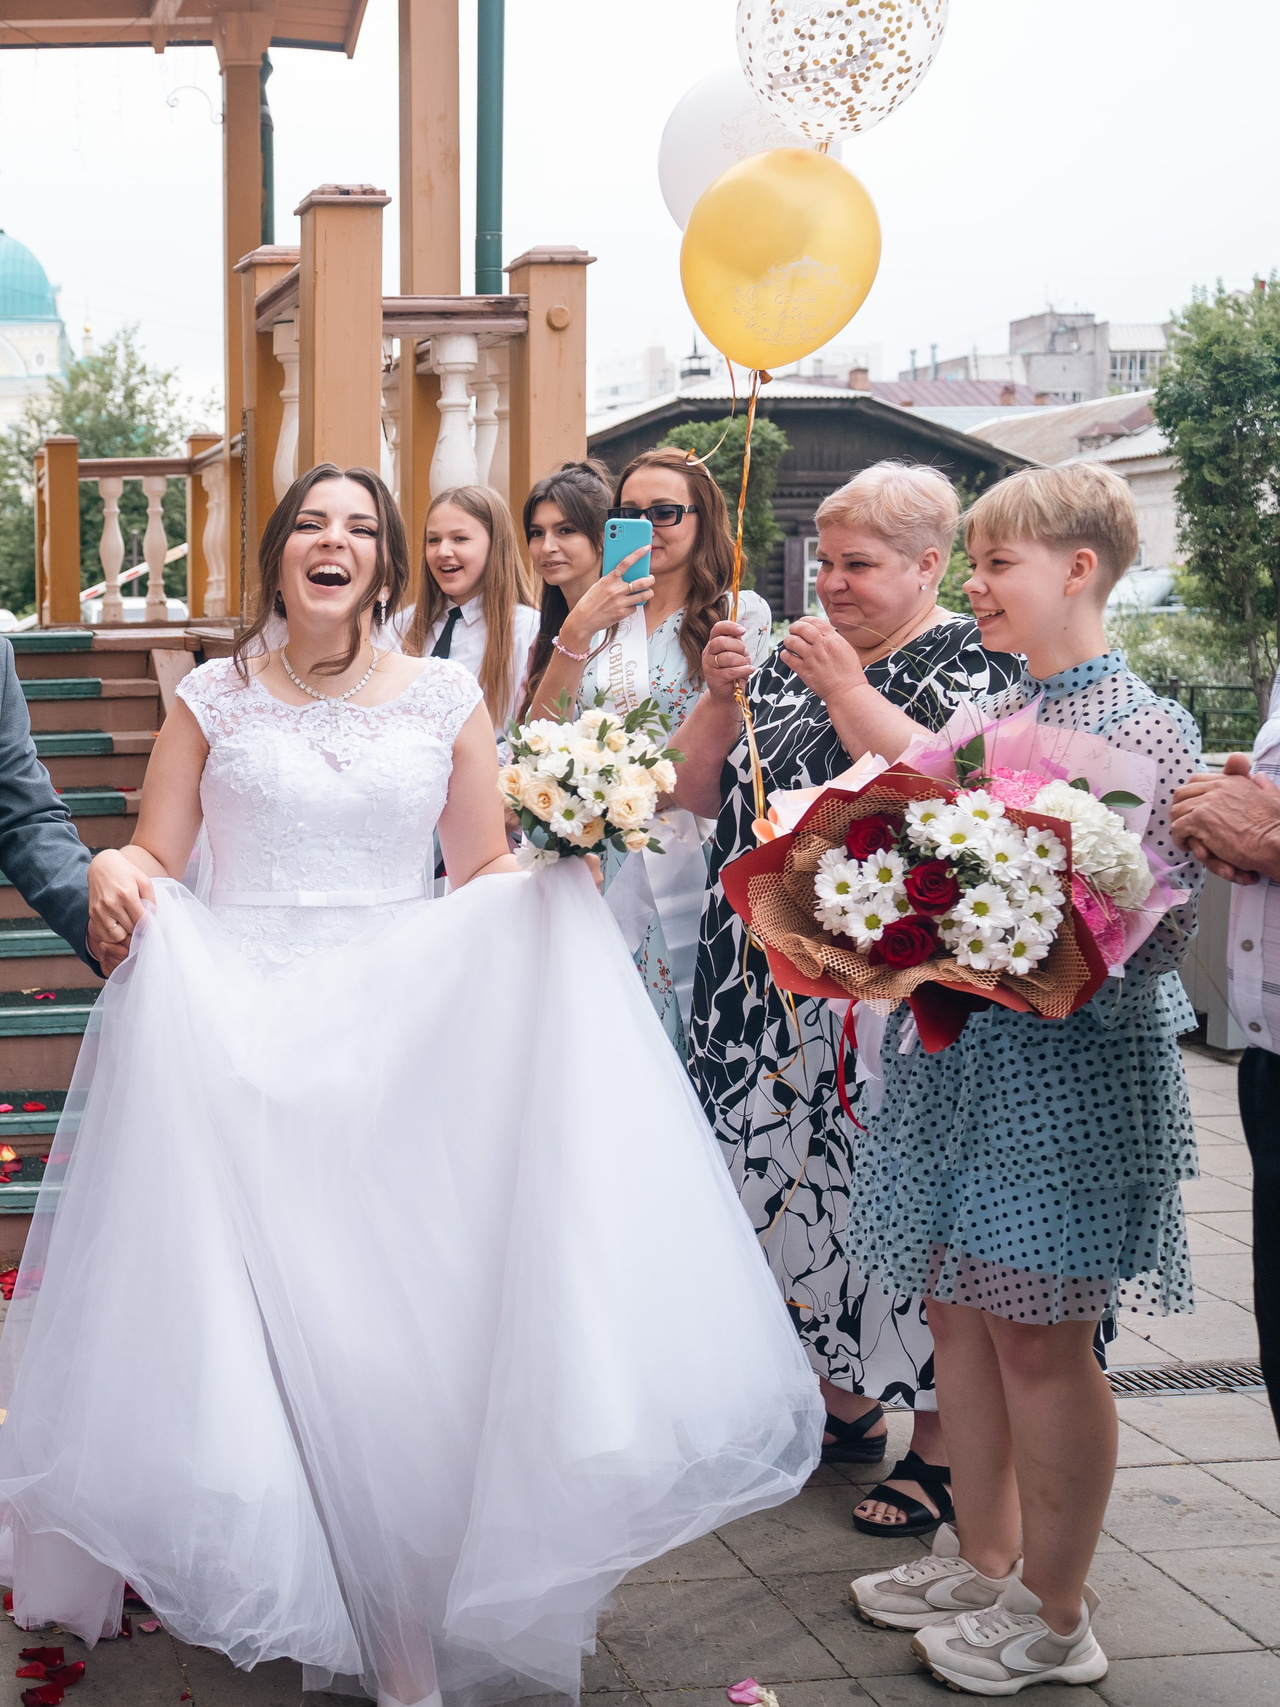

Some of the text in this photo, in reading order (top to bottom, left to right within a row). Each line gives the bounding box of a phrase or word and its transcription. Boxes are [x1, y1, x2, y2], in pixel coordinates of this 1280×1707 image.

[774, 291, 820, 305] Совет
[761, 308, 818, 321] Любовь
[625, 660, 639, 709] Самая
